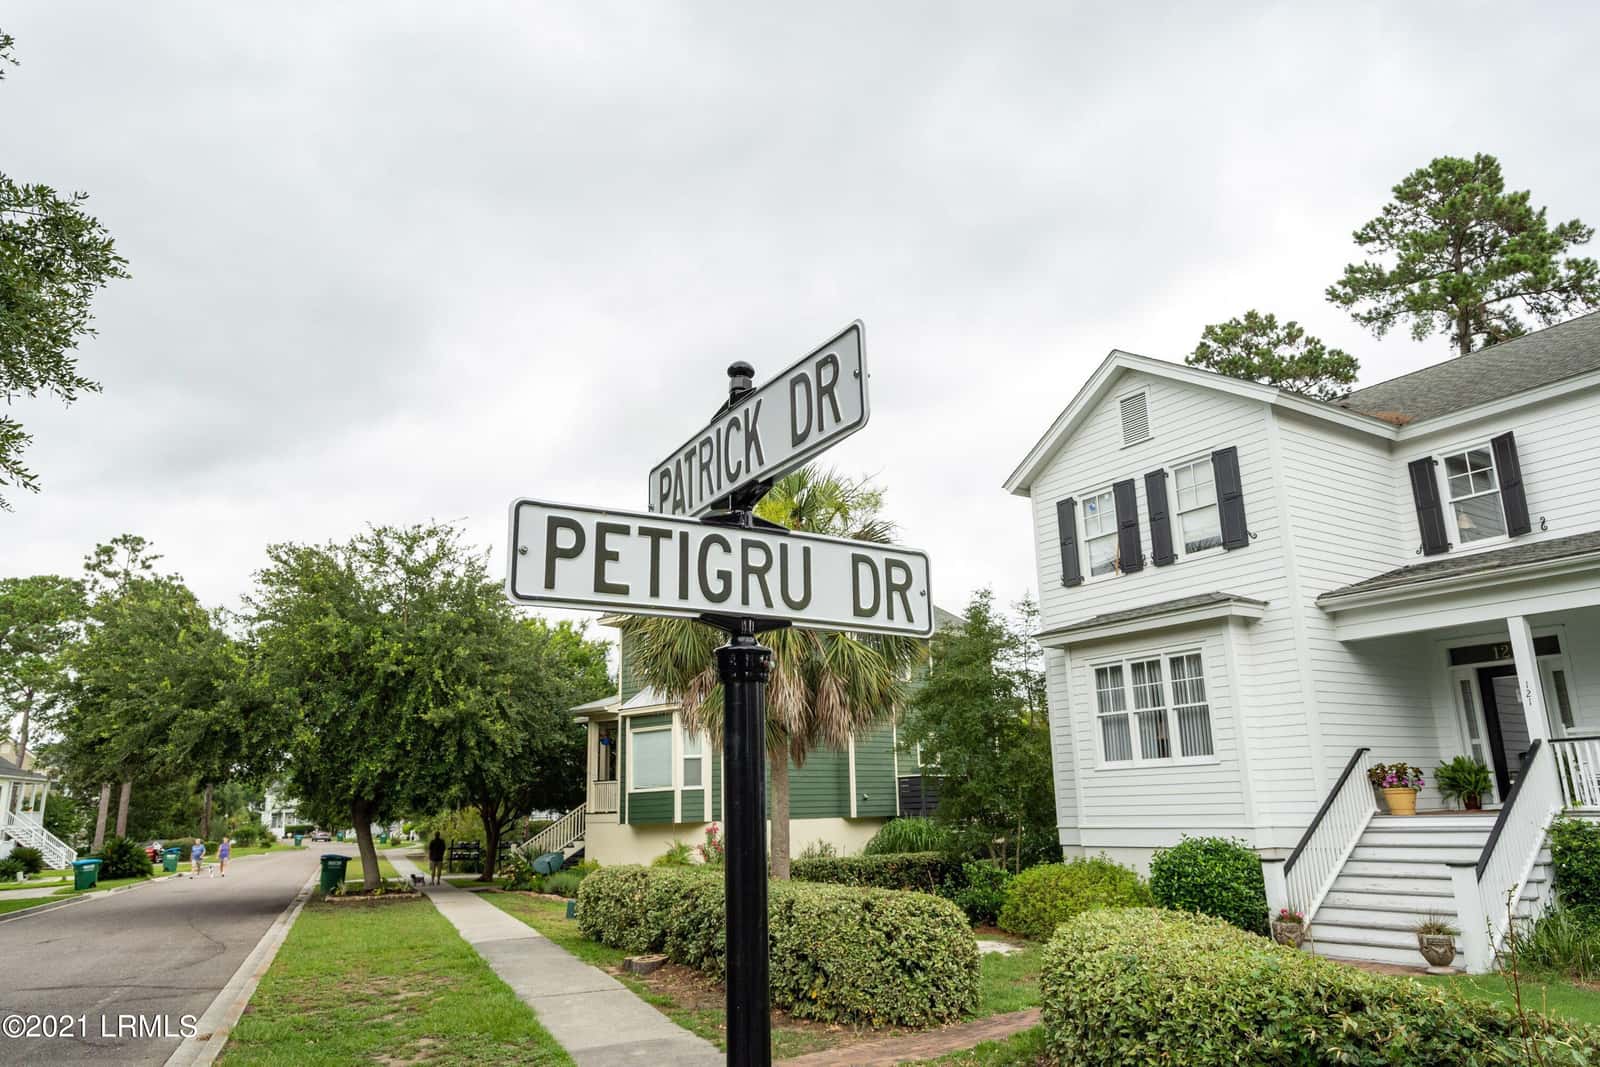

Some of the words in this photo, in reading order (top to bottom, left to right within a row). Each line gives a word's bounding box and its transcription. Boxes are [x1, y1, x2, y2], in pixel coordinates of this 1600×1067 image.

[659, 398, 765, 515] PATRICK
[789, 353, 842, 448] DR
[543, 515, 812, 611] PETIGRU
[851, 552, 915, 624] DR
